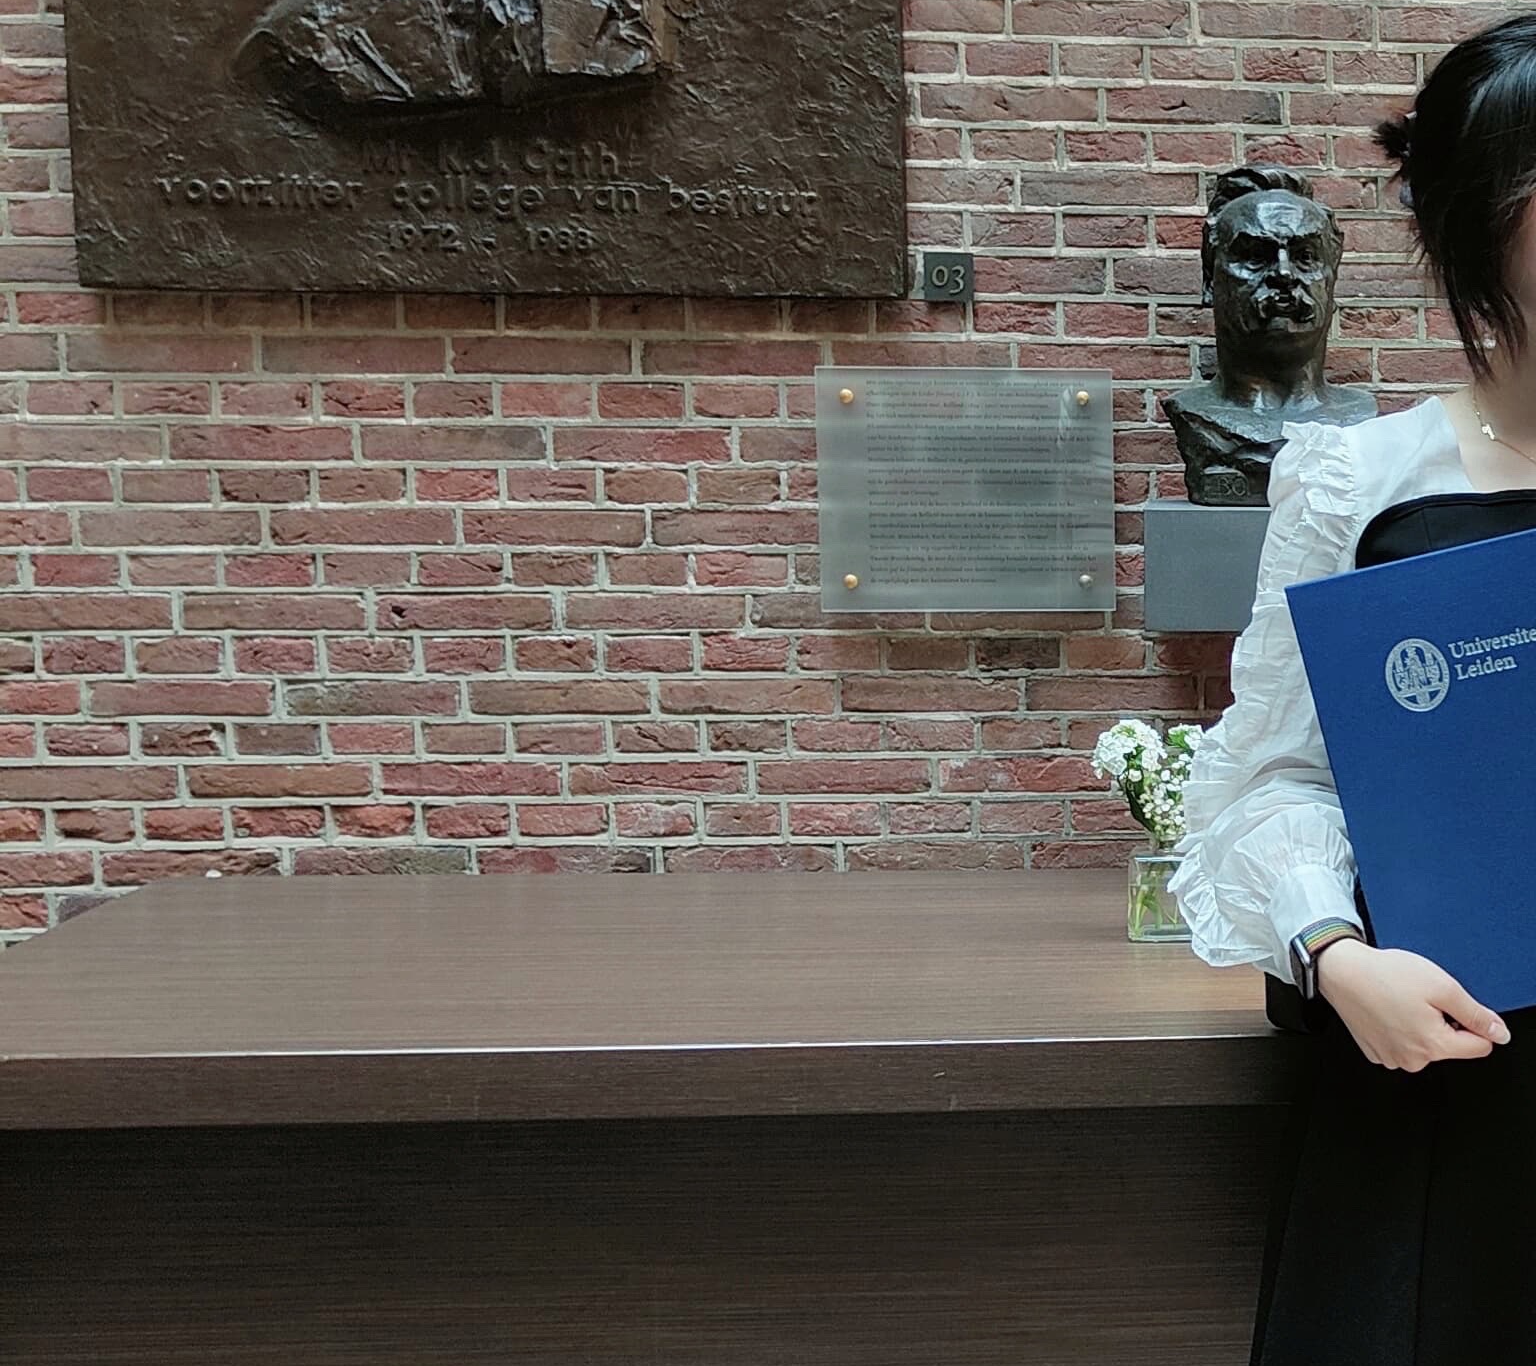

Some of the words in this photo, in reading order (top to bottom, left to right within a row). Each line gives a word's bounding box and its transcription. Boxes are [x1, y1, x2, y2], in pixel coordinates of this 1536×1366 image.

[391, 172, 545, 221] college
[567, 182, 642, 214] van
[668, 177, 818, 217] bestuur
[931, 265, 966, 294] 03
[1455, 654, 1517, 680] Leiden
